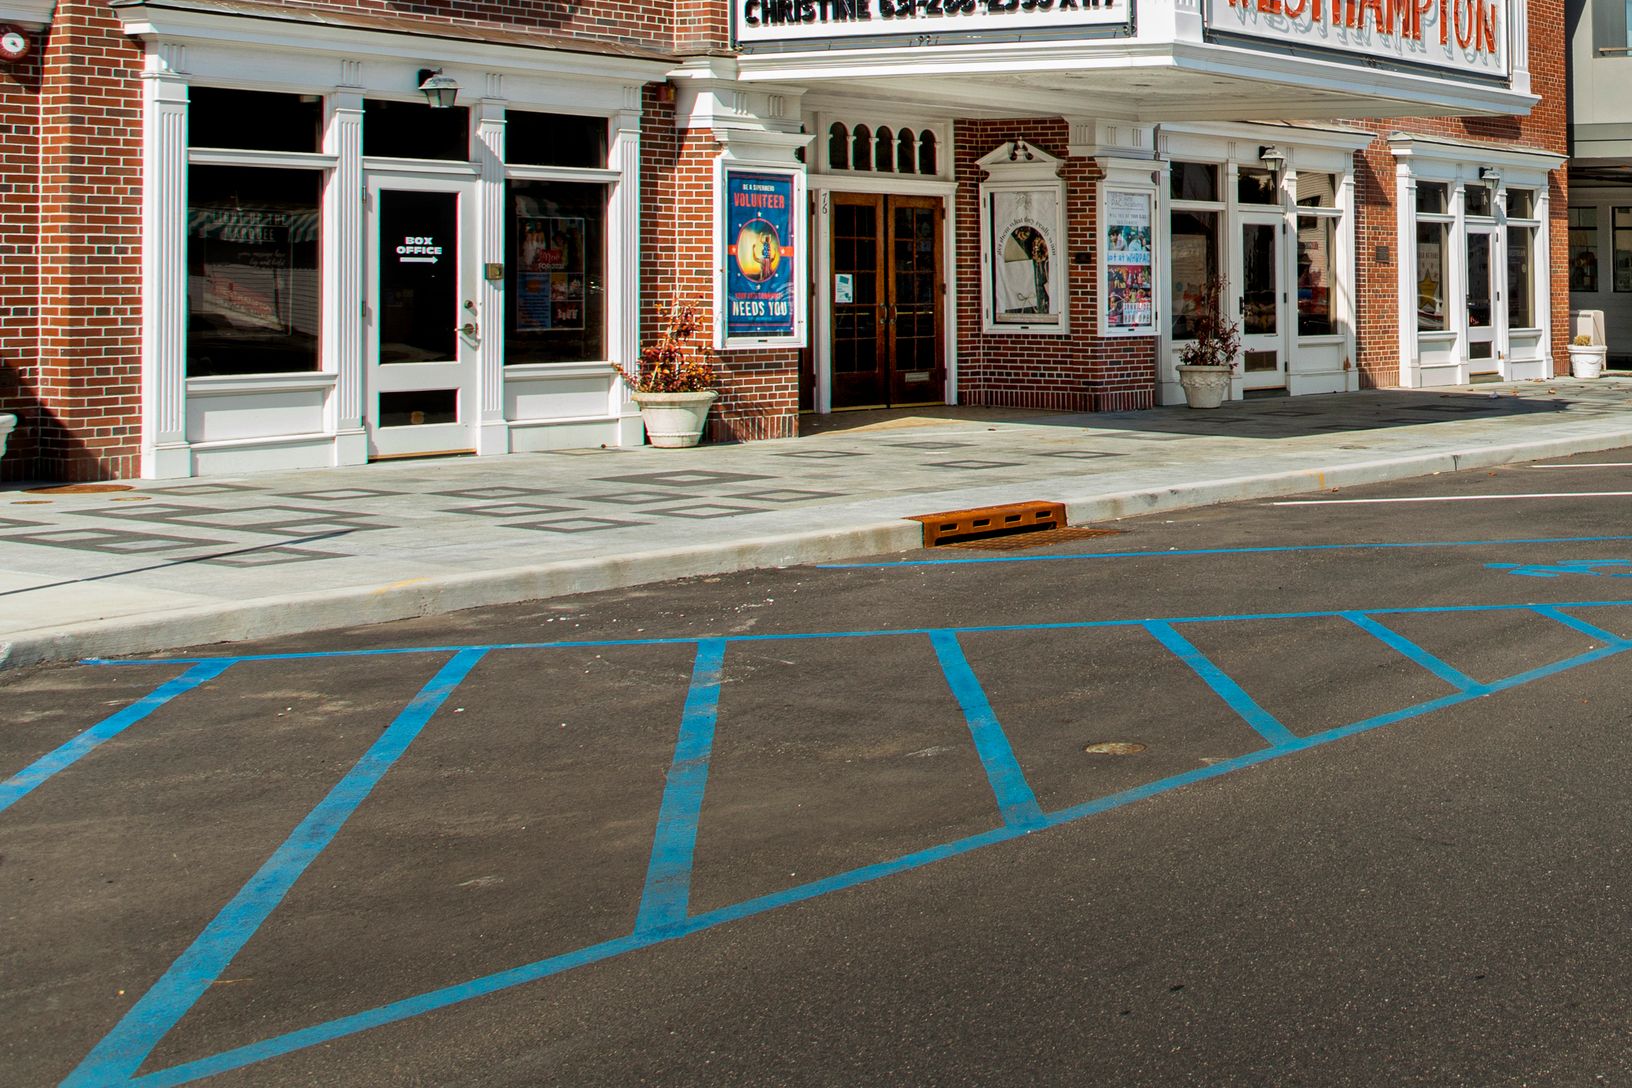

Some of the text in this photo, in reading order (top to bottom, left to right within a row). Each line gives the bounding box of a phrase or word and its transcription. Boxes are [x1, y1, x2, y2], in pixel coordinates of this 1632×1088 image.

[734, 192, 785, 209] VOLUNTEER
[1010, 217, 1023, 228] what
[1024, 216, 1035, 225] they
[1036, 221, 1050, 237] really
[404, 236, 433, 245] BOX
[396, 245, 443, 255] OFFICE
[732, 301, 788, 316] NEEDS YOU
